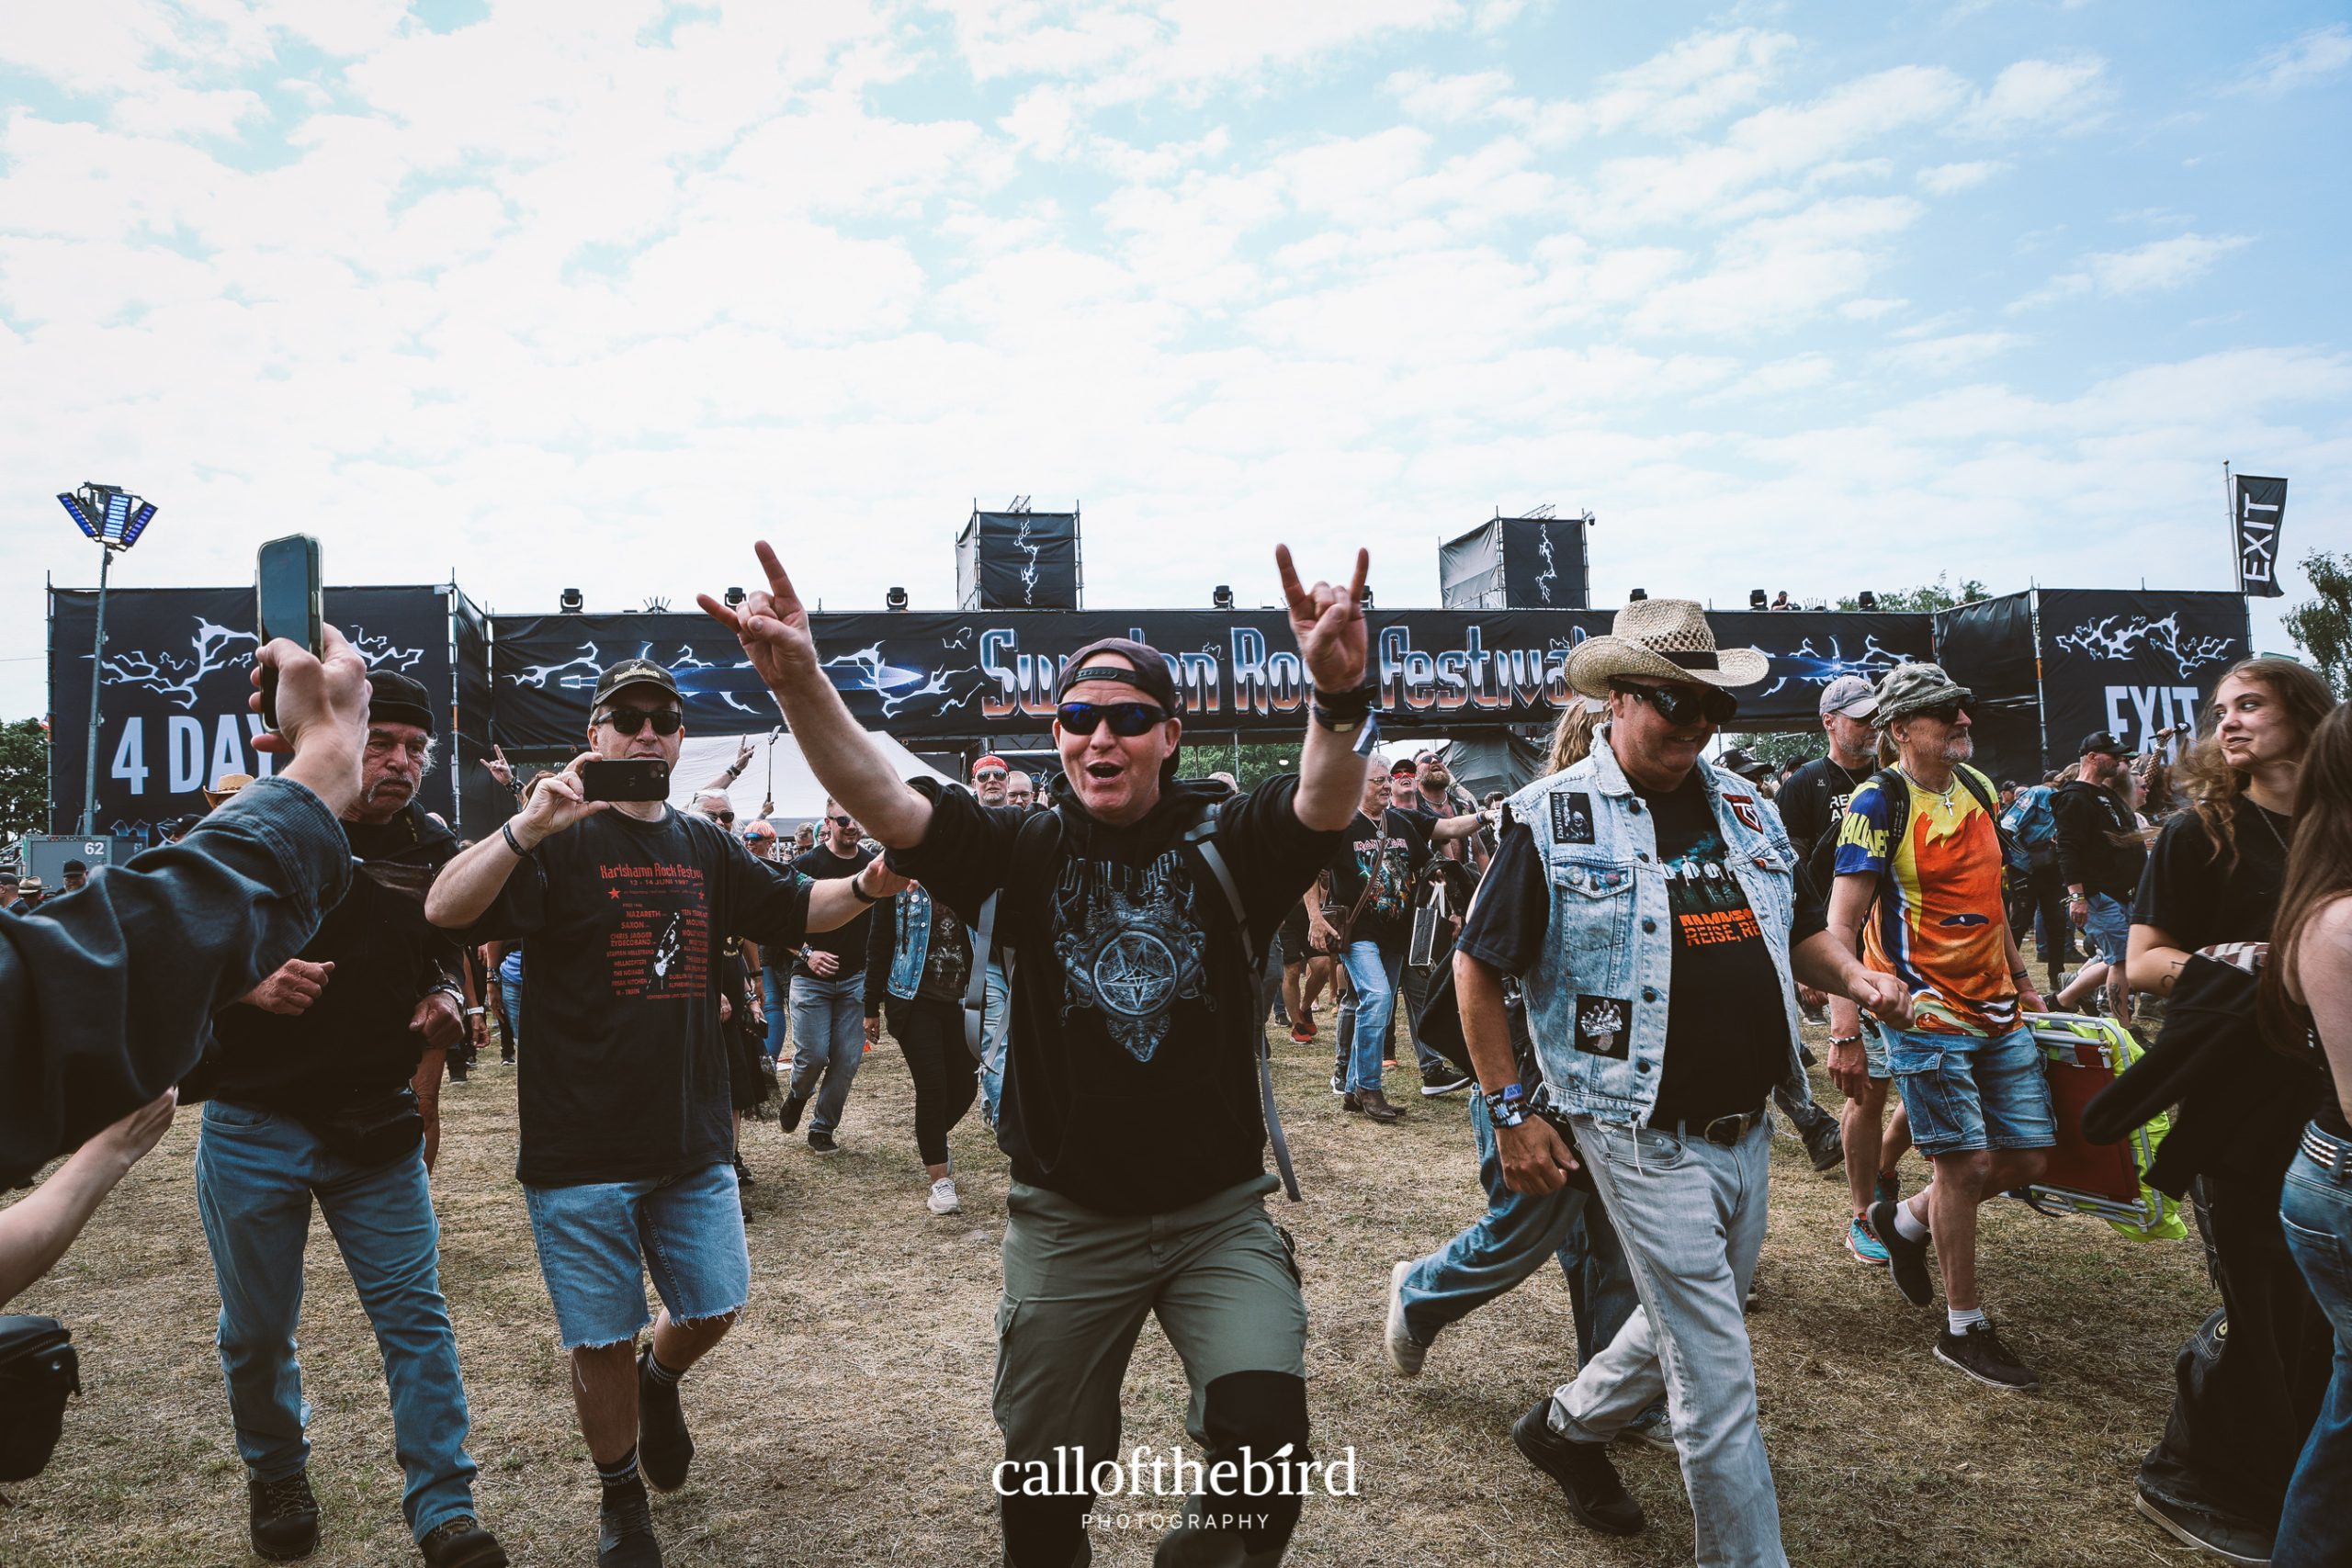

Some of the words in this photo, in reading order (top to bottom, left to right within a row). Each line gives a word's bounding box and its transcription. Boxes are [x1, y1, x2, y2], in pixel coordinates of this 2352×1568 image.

[2243, 492, 2278, 581] EXIT
[2105, 685, 2199, 765] EXIT
[111, 716, 149, 795] 4
[168, 714, 274, 794] DAY
[85, 841, 105, 855] 62
[600, 863, 653, 879] Karlshamn
[654, 863, 677, 877] Rock
[1679, 908, 1753, 927] RAMMS+
[1684, 923, 1741, 946] REISE,
[1738, 920, 1761, 938] RE
